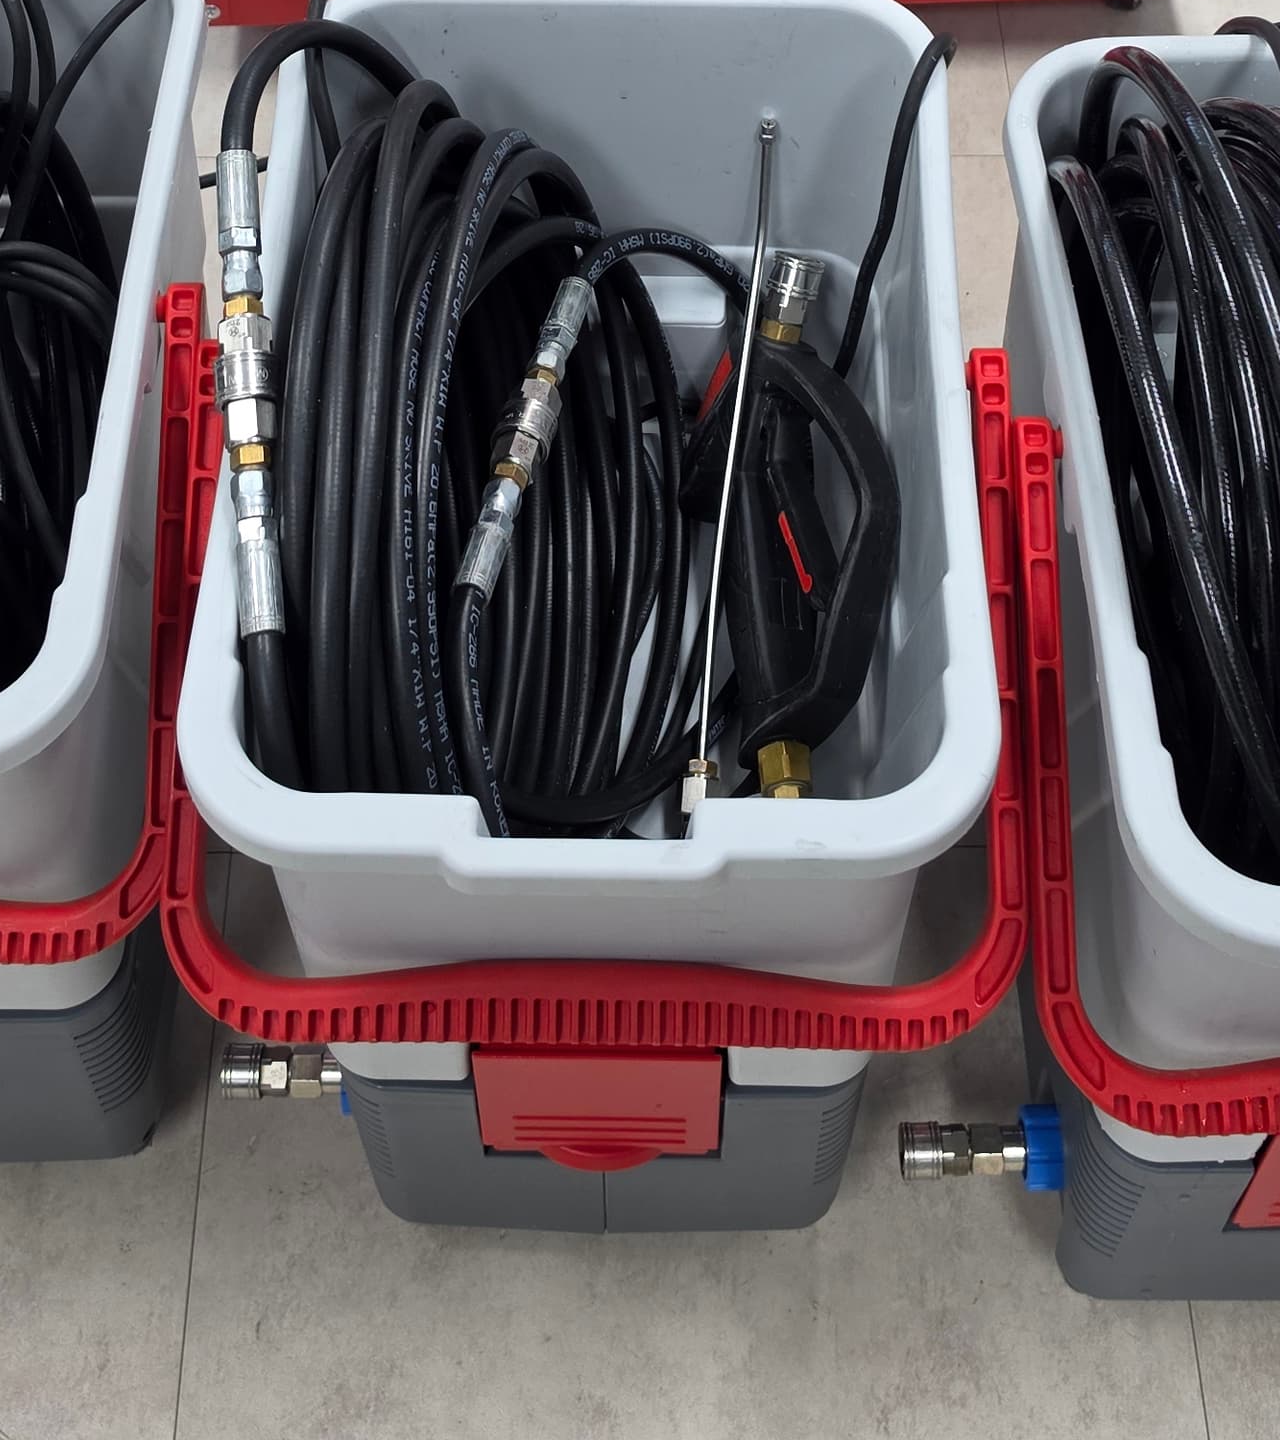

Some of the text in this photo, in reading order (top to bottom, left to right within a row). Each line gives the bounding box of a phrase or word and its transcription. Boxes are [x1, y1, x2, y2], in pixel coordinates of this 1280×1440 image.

[476, 190, 487, 208] NO
[465, 208, 481, 248] SKIVE
[470, 677, 486, 733] MADE
[481, 744, 495, 772] IN
[489, 779, 511, 837] KORE
